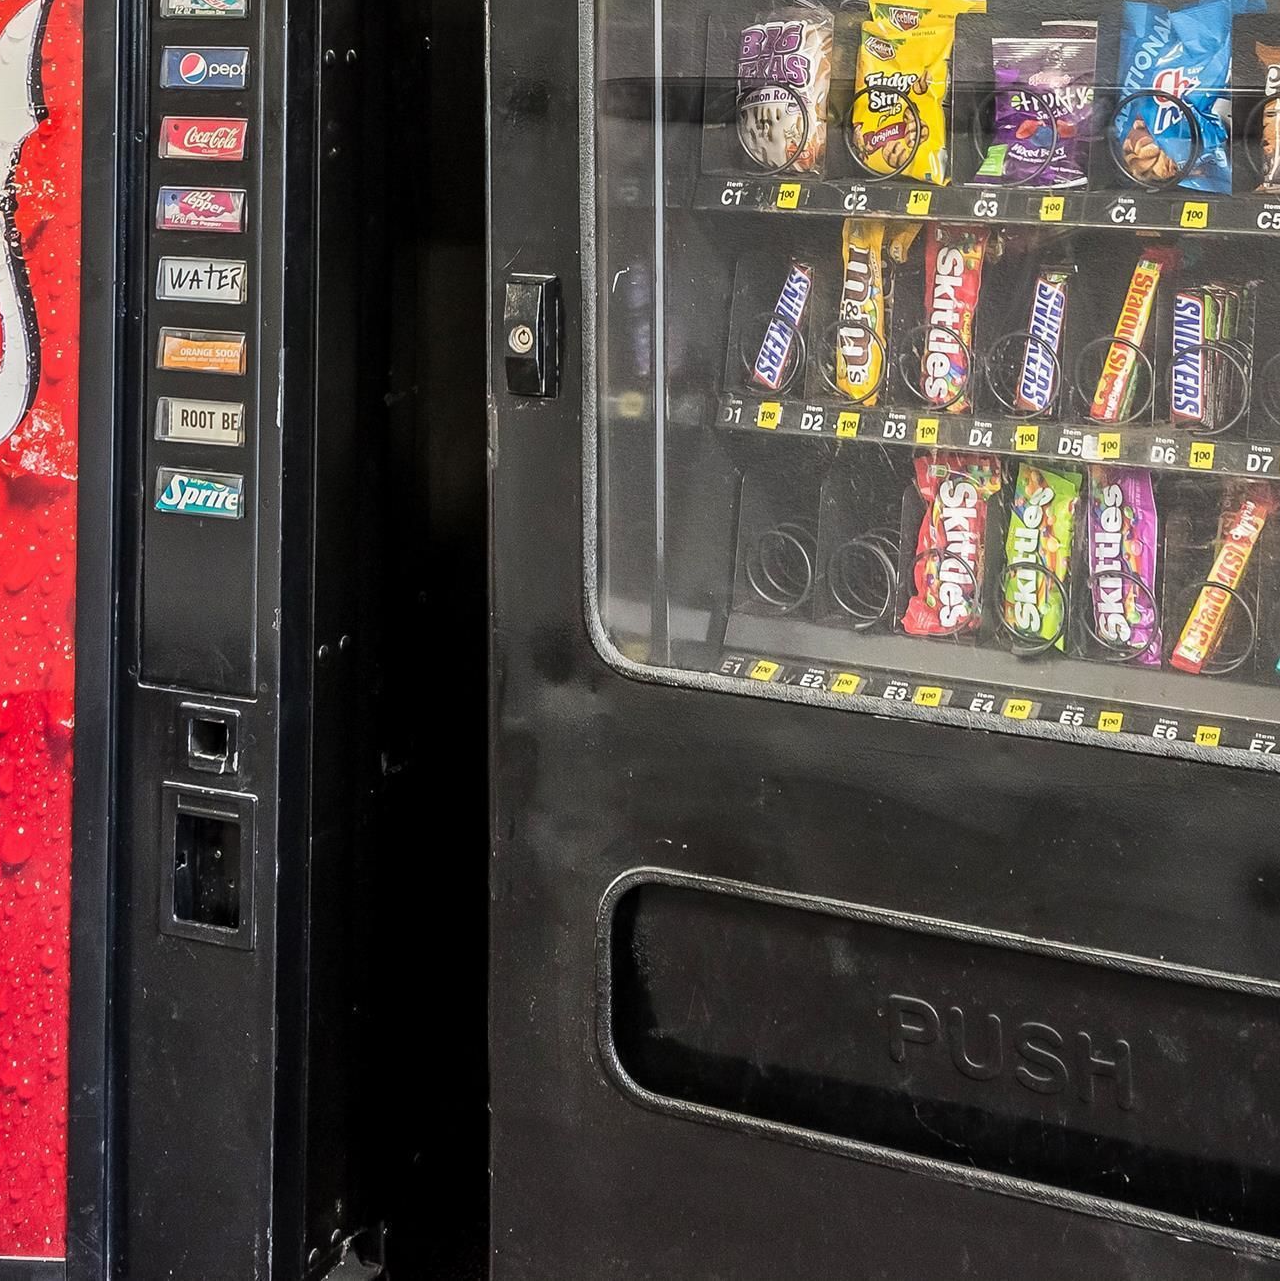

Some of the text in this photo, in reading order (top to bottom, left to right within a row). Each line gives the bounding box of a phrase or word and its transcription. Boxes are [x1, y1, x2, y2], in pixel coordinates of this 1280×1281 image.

[739, 25, 803, 59] BIG
[866, 73, 917, 92] Fudge
[184, 126, 240, 149] Coca-Cola
[871, 125, 900, 145] Original
[1111, 206, 1137, 224] C4
[925, 247, 965, 399] Skittles
[180, 348, 240, 358] ORANGE SODA
[1173, 299, 1202, 417] SNICKERS
[181, 409, 239, 431] ROOT BE
[800, 414, 824, 431] D2
[1150, 445, 1176, 464] D6
[1246, 454, 1273, 472] D7
[161, 474, 239, 511] Sprite
[939, 481, 977, 628] Skittles
[1013, 486, 1055, 633] Skittles
[1095, 484, 1131, 642] Skittles
[883, 685, 907, 700] E3
[1152, 725, 1178, 740] E6
[888, 994, 1134, 1111] PUSH
